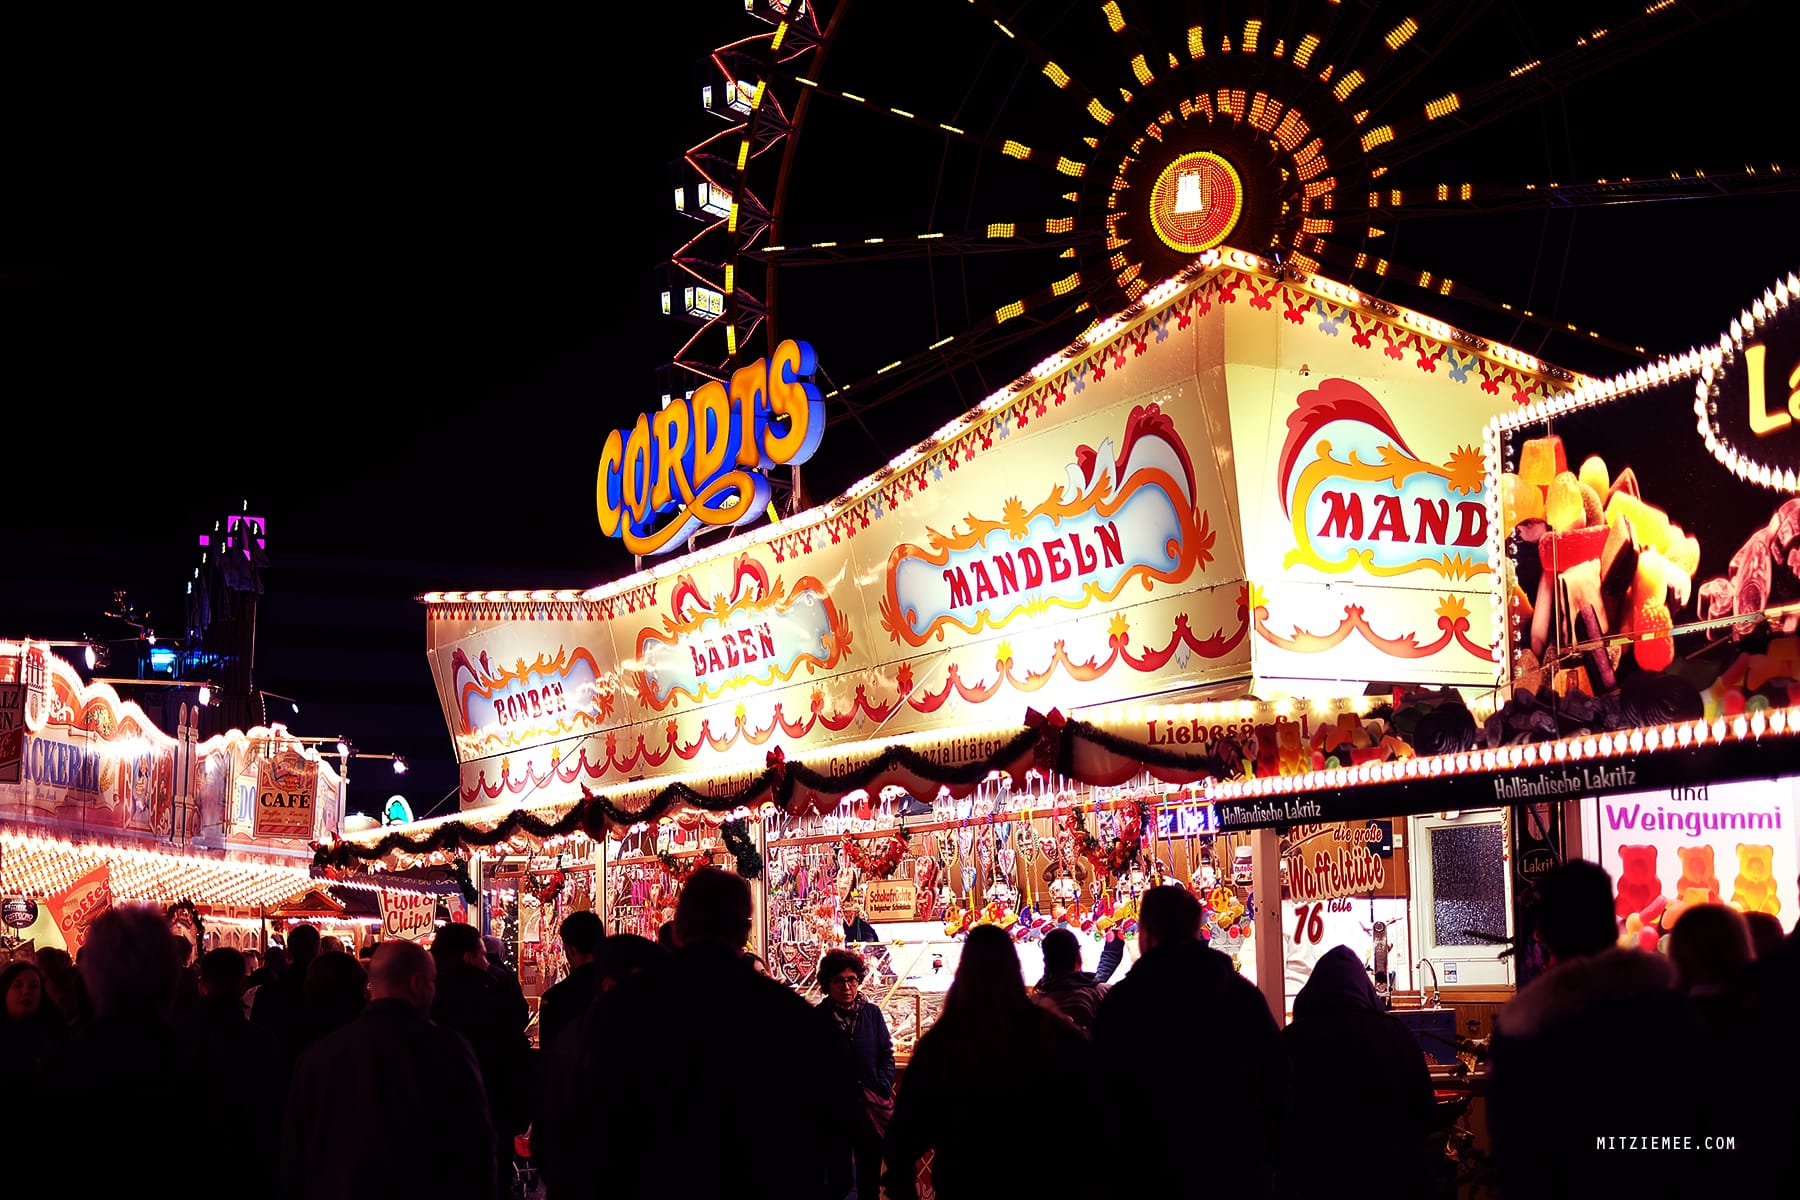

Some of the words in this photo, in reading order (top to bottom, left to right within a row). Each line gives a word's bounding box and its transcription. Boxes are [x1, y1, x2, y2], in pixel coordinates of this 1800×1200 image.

[596, 339, 826, 556] CORDTS
[1317, 490, 1488, 547] MAND
[943, 521, 1125, 610] MANDELN
[689, 621, 777, 678] LADEN
[493, 682, 567, 727] BONBON
[260, 790, 311, 809] CAFÉ
[1494, 770, 1581, 800] Holländische
[1584, 766, 1637, 791] Lakritz
[1222, 802, 1283, 825] Holländische
[1285, 798, 1322, 820] Lakritz
[1605, 804, 1782, 837] Weingummi
[1333, 824, 1352, 842] die
[1354, 823, 1383, 846] große
[1287, 847, 1384, 902] Waffeltüte
[1523, 858, 1556, 873] Lakrit
[60, 878, 110, 932] Coffee
[381, 889, 421, 912] Fish
[1327, 898, 1353, 914] Teile
[386, 911, 432, 935] Chips
